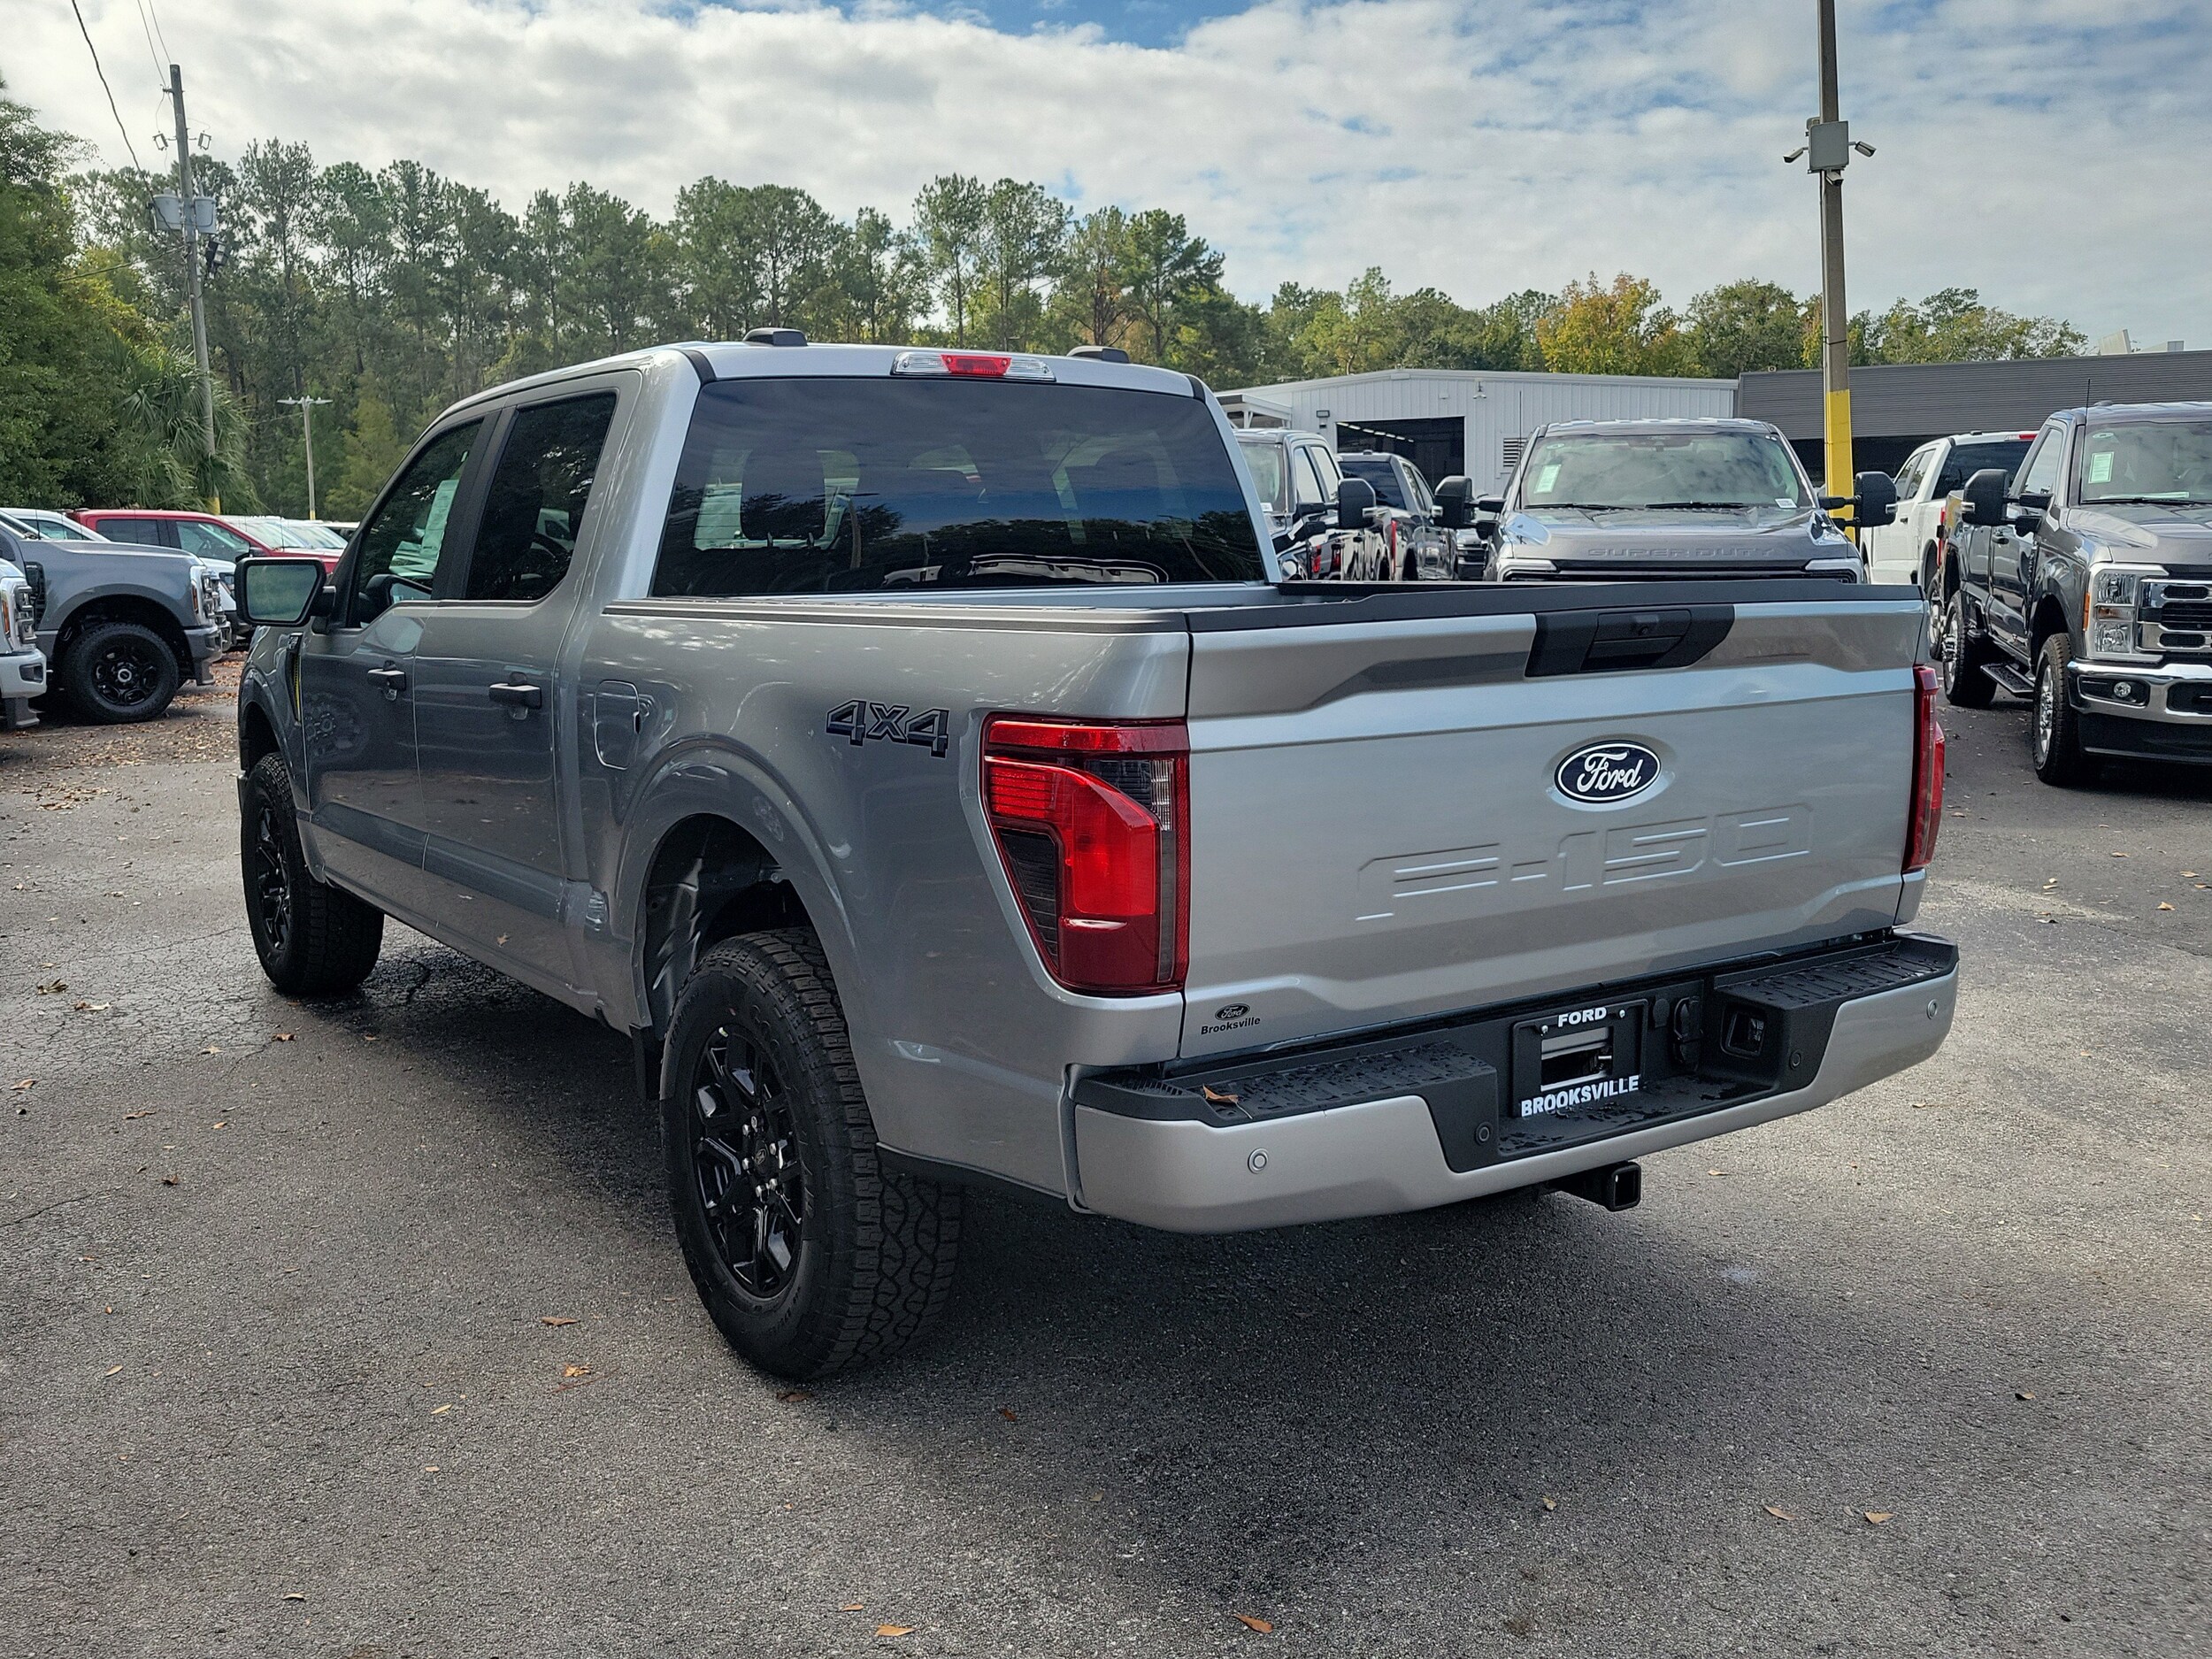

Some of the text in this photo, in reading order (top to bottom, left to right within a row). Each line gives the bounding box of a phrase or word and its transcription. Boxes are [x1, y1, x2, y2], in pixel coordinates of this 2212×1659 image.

[1587, 547, 1774, 557] SUPER DUTY
[1576, 750, 1642, 793] Ford
[1356, 803, 1814, 920] F-150
[1220, 1006, 1244, 1018] Ford
[1557, 1007, 1607, 1027] FORD
[1201, 1017, 1261, 1035] Brooksville
[1520, 1074, 1640, 1118] BROOKSVILLE
